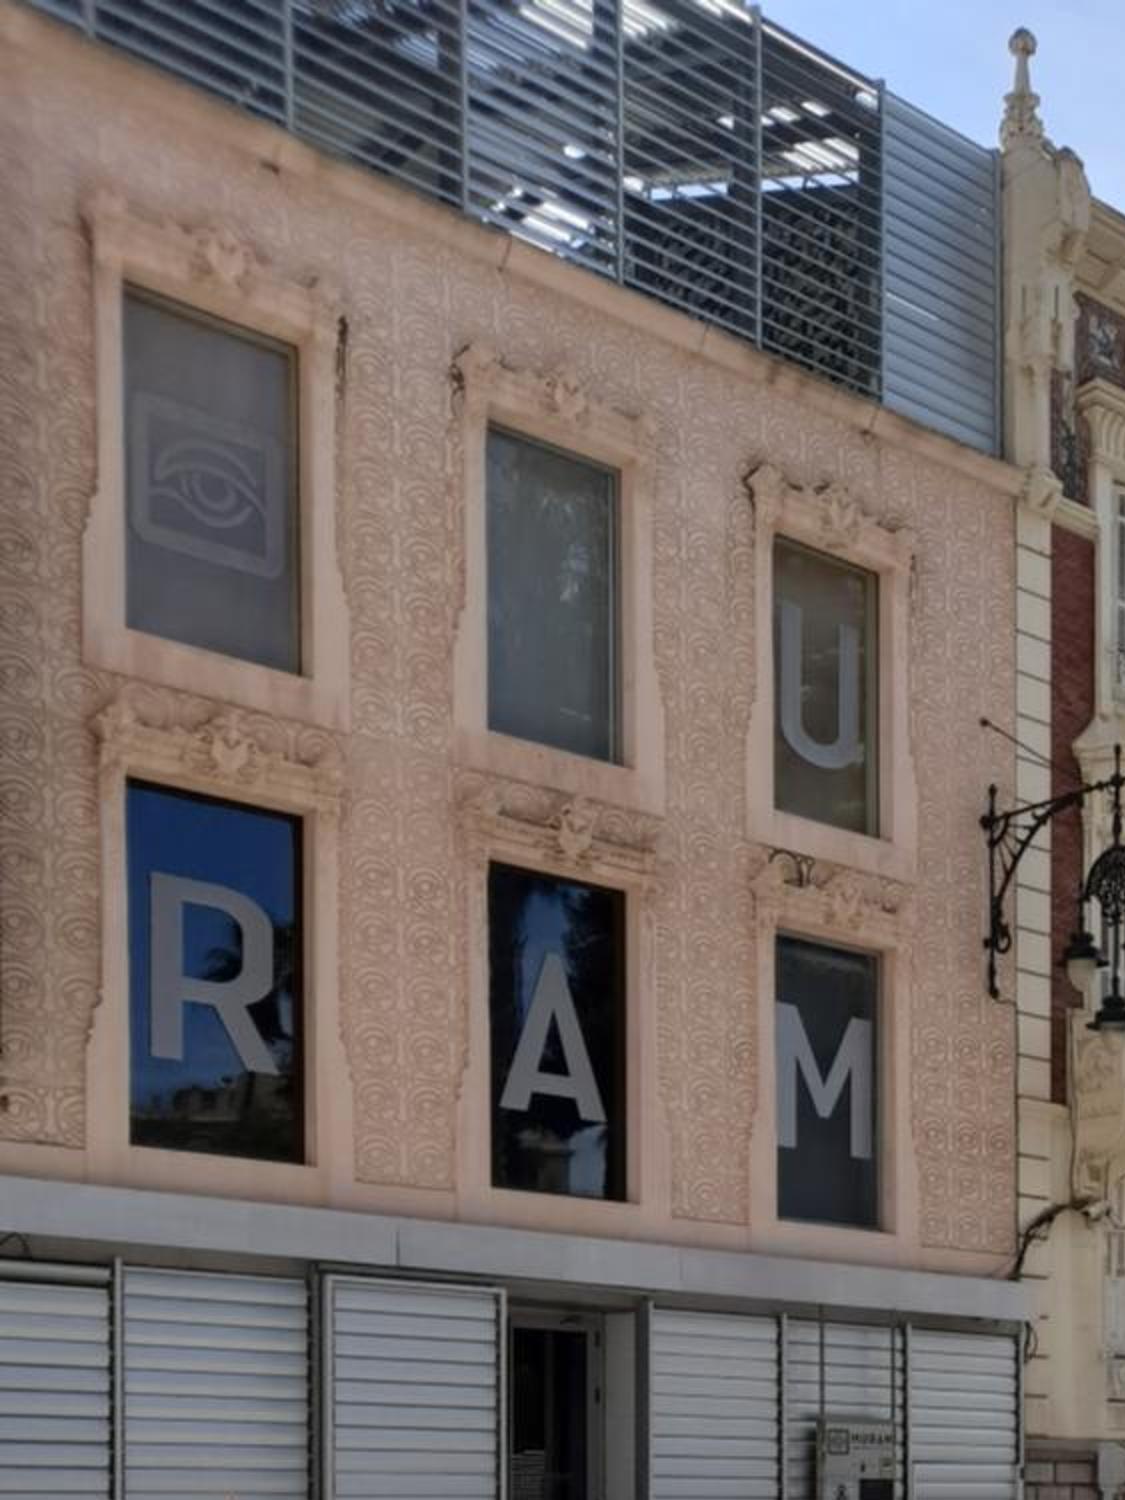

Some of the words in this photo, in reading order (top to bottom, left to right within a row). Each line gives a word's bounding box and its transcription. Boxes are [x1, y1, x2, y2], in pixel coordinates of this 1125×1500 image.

[777, 600, 863, 771] U
[148, 872, 279, 1075] R
[499, 952, 608, 1124] A
[776, 1001, 874, 1161] M
